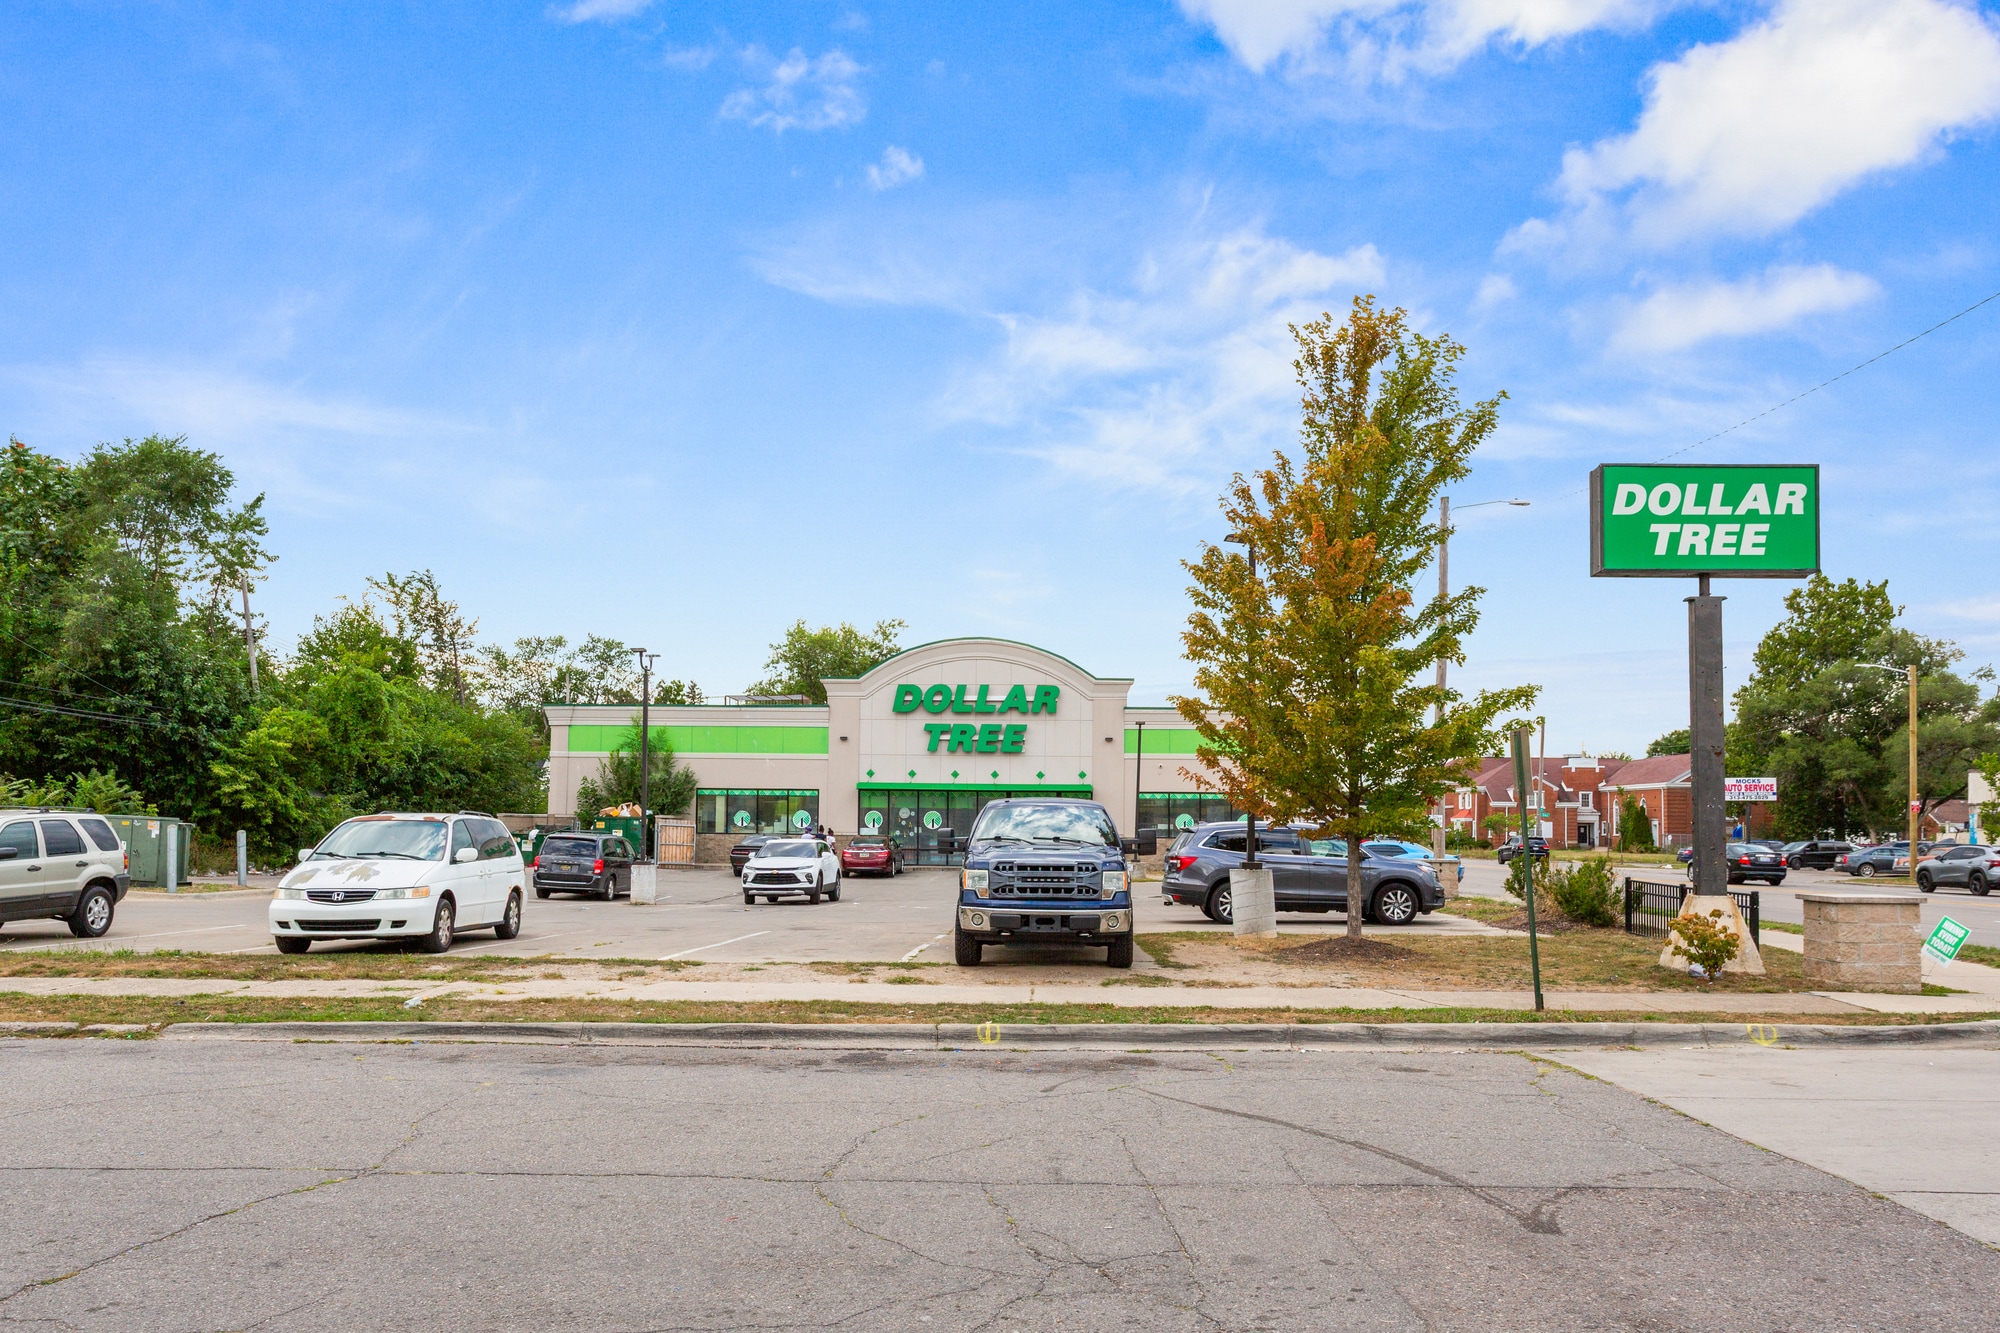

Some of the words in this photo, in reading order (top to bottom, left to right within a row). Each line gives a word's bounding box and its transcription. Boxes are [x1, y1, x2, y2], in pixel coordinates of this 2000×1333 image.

[1612, 483, 1808, 516] DOLLAR
[1649, 523, 1770, 556] TREE
[892, 683, 1061, 714] DOLLAR
[923, 723, 1028, 753] TREE
[1724, 784, 1742, 792] AUTO
[1744, 784, 1774, 792] SERVICE
[1937, 929, 1959, 946] EVENT
[1942, 920, 1966, 938] HIRING
[1930, 936, 1955, 956] TODAY!
